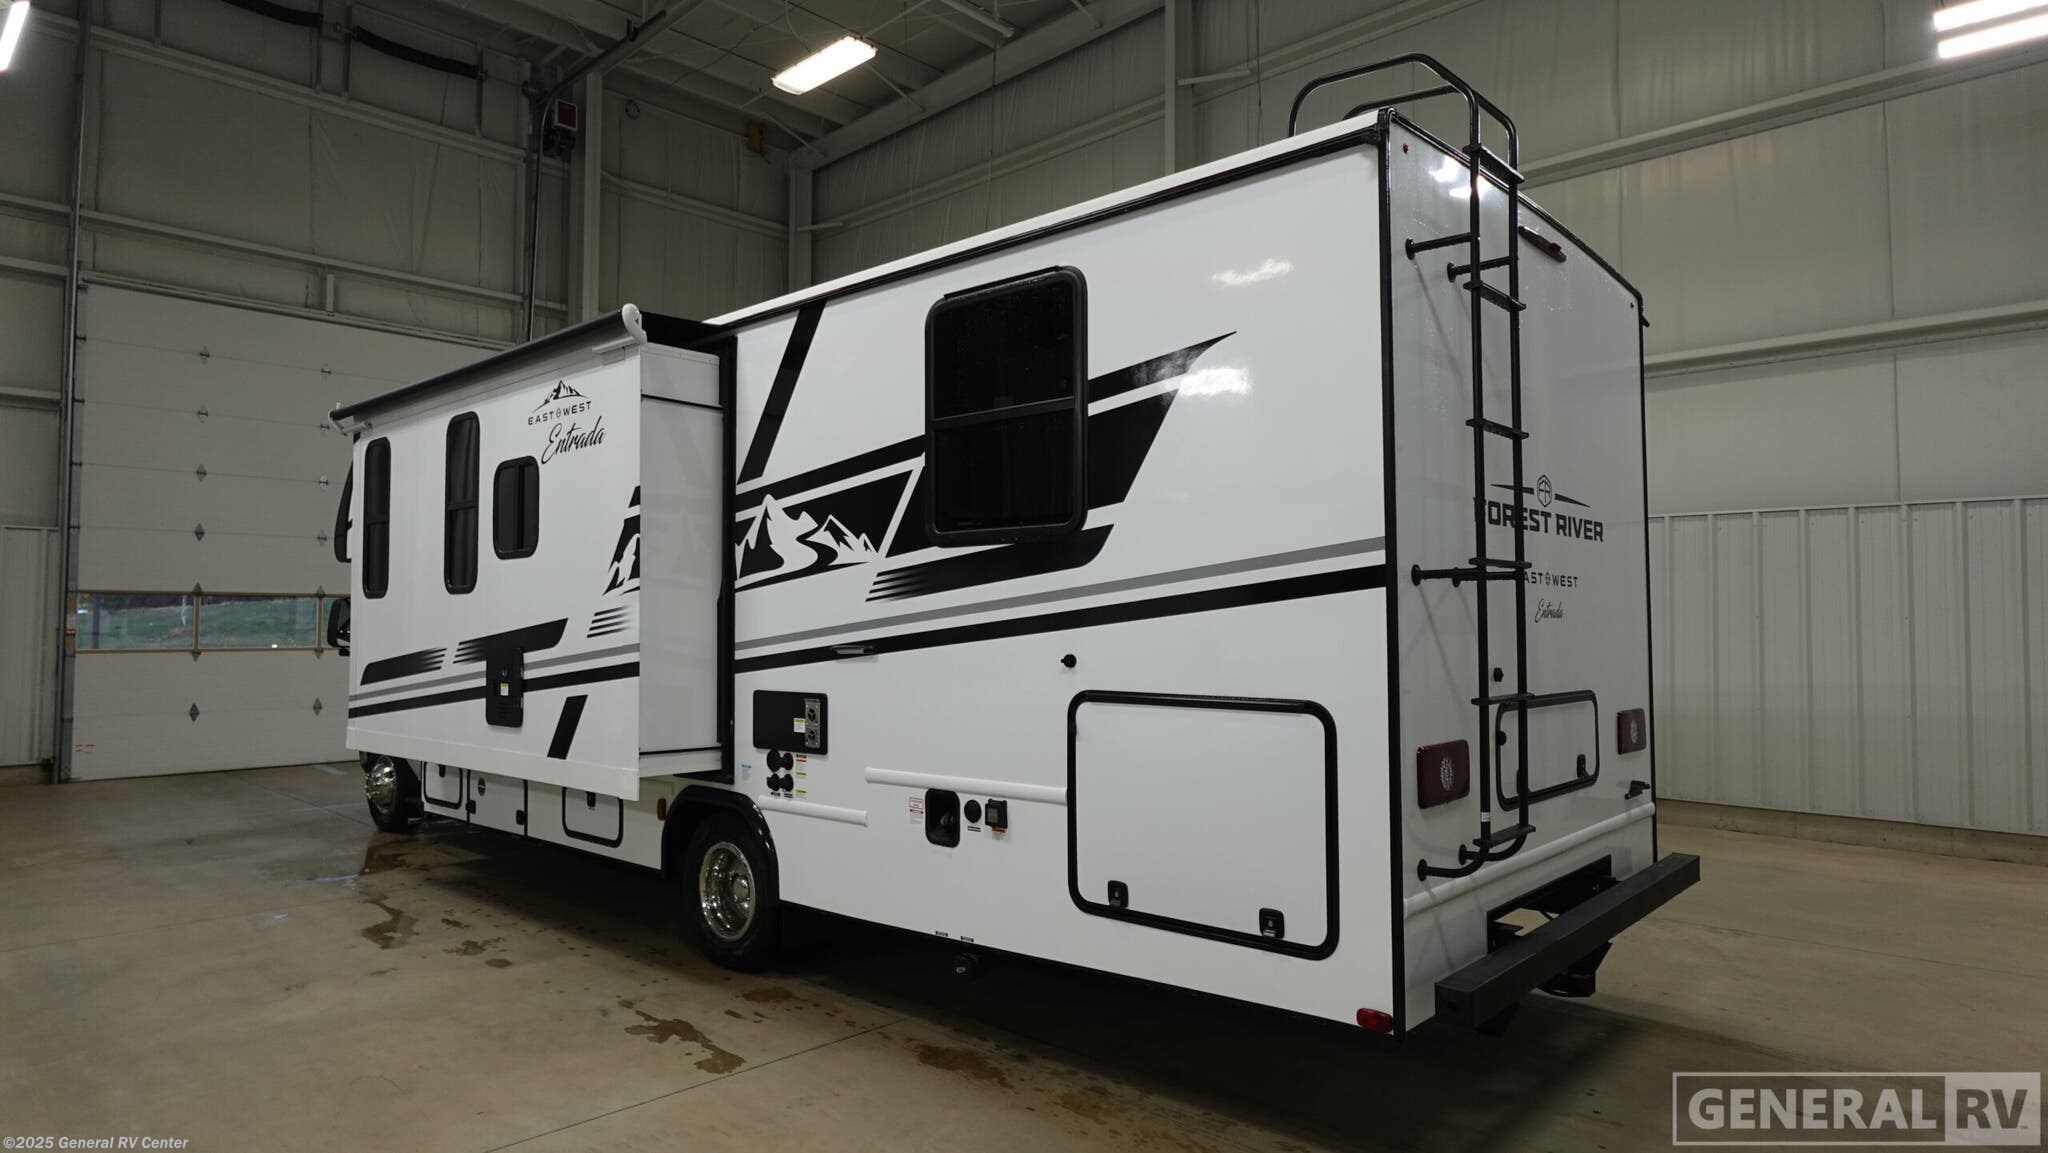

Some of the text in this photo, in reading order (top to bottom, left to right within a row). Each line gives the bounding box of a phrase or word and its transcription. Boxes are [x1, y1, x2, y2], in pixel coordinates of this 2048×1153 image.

[528, 400, 592, 426] EAST WEST
[541, 415, 606, 465] Entrada
[1473, 496, 1604, 543] OREST RIVER
[1551, 574, 1579, 588] WEST
